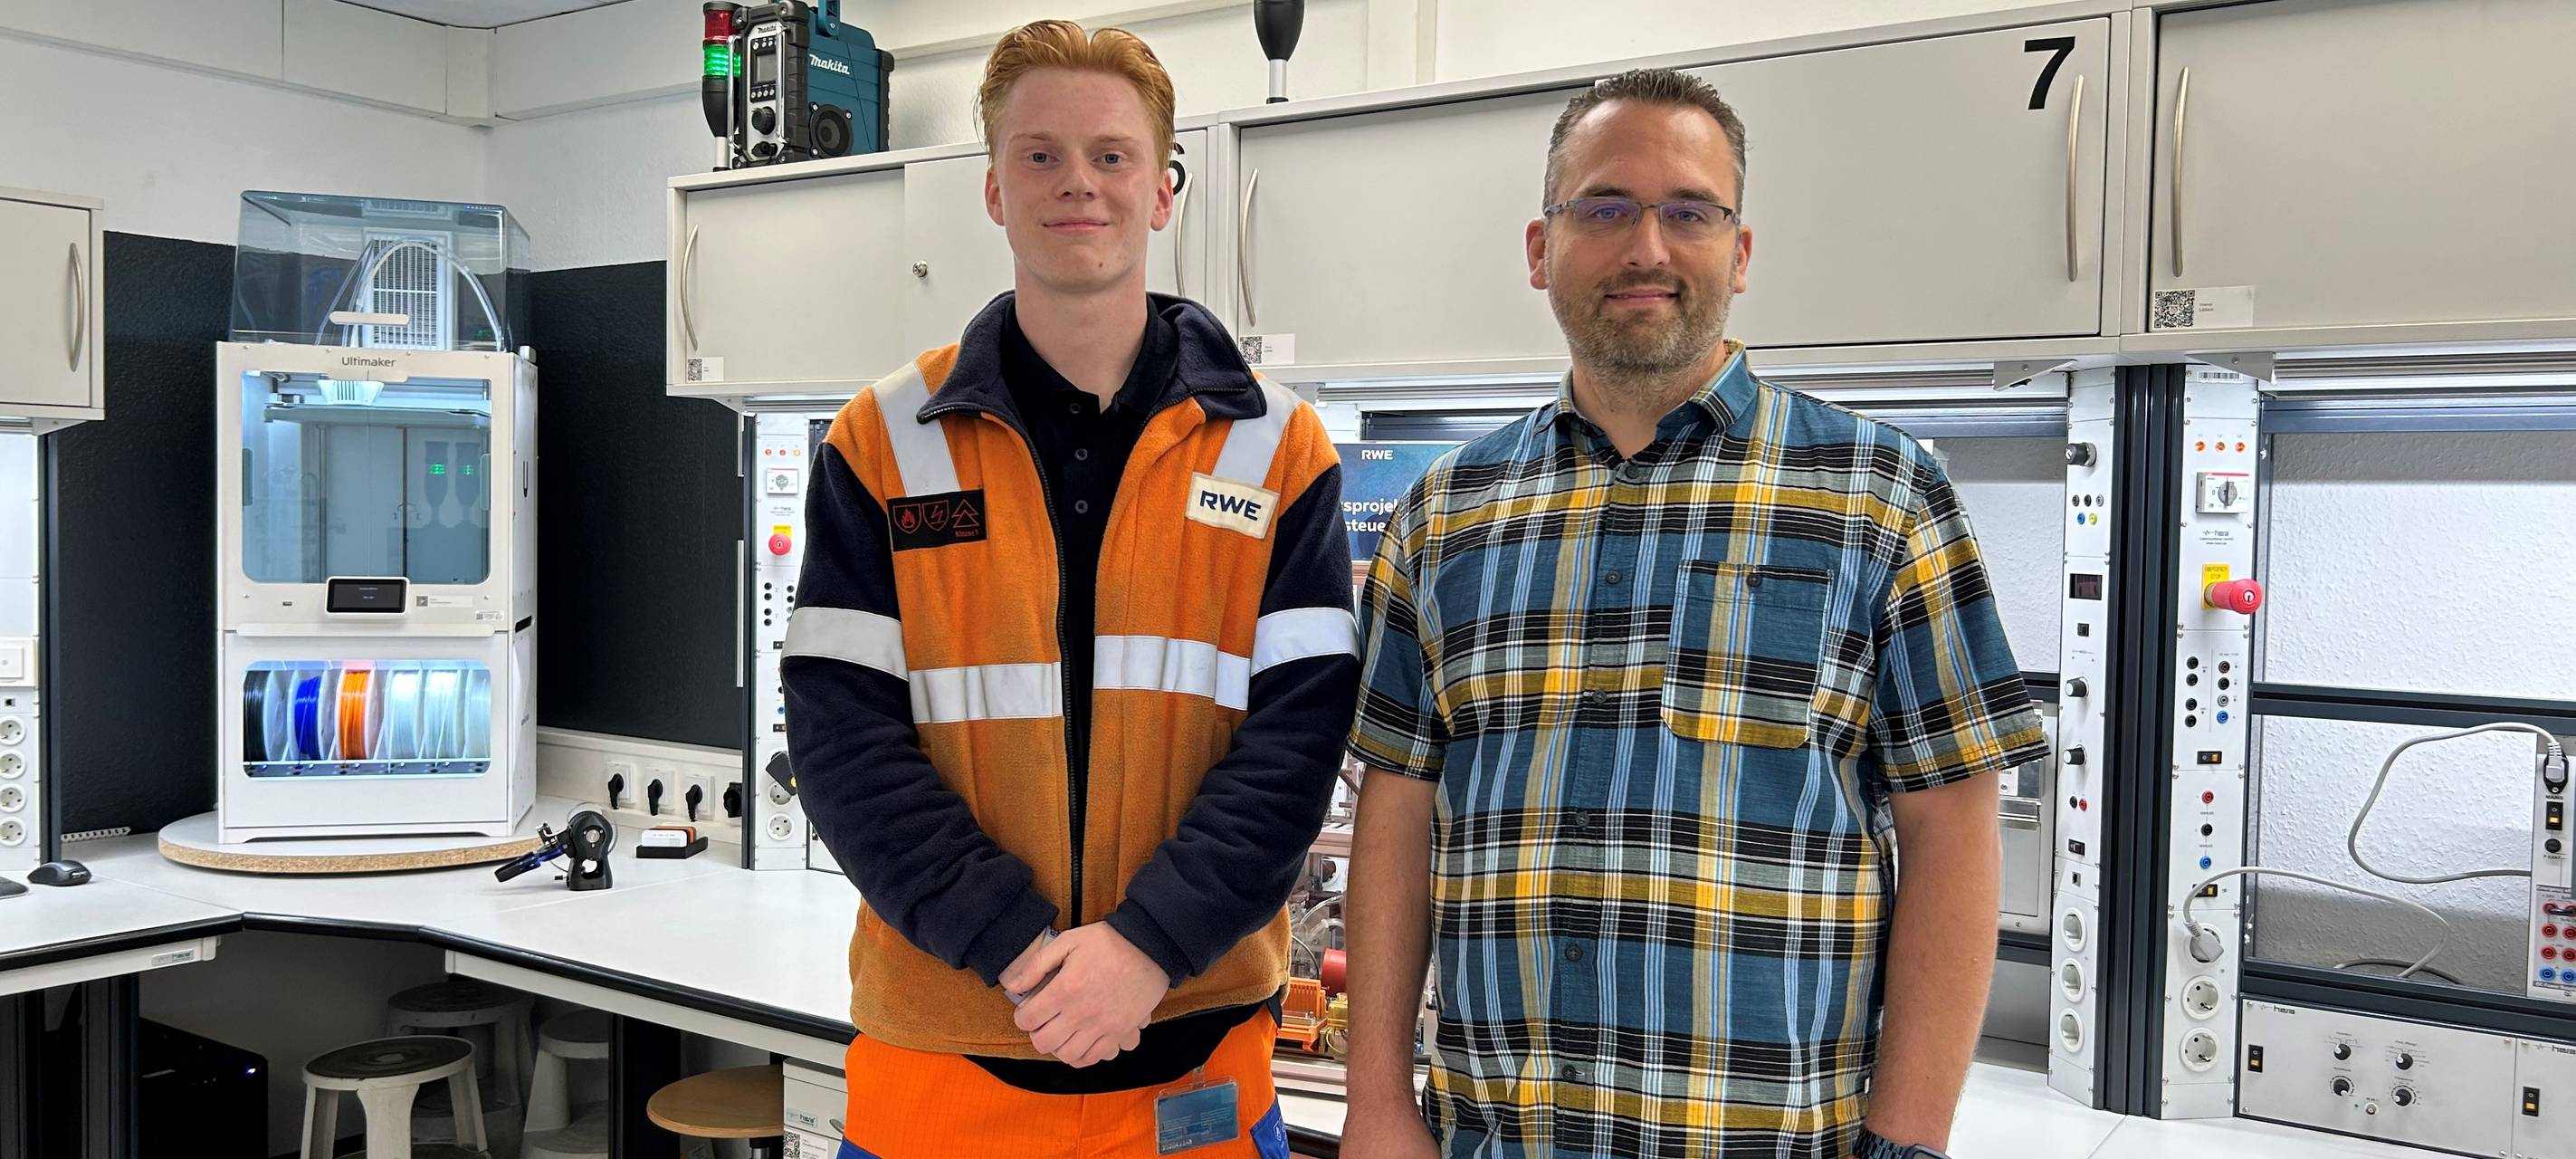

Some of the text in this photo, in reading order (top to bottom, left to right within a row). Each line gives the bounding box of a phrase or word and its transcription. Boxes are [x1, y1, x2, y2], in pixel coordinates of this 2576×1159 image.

[2024, 36, 2075, 110] 7
[341, 356, 396, 367] Ultimaker
[1361, 449, 1393, 460] RWE
[1199, 490, 1262, 522] RWE
